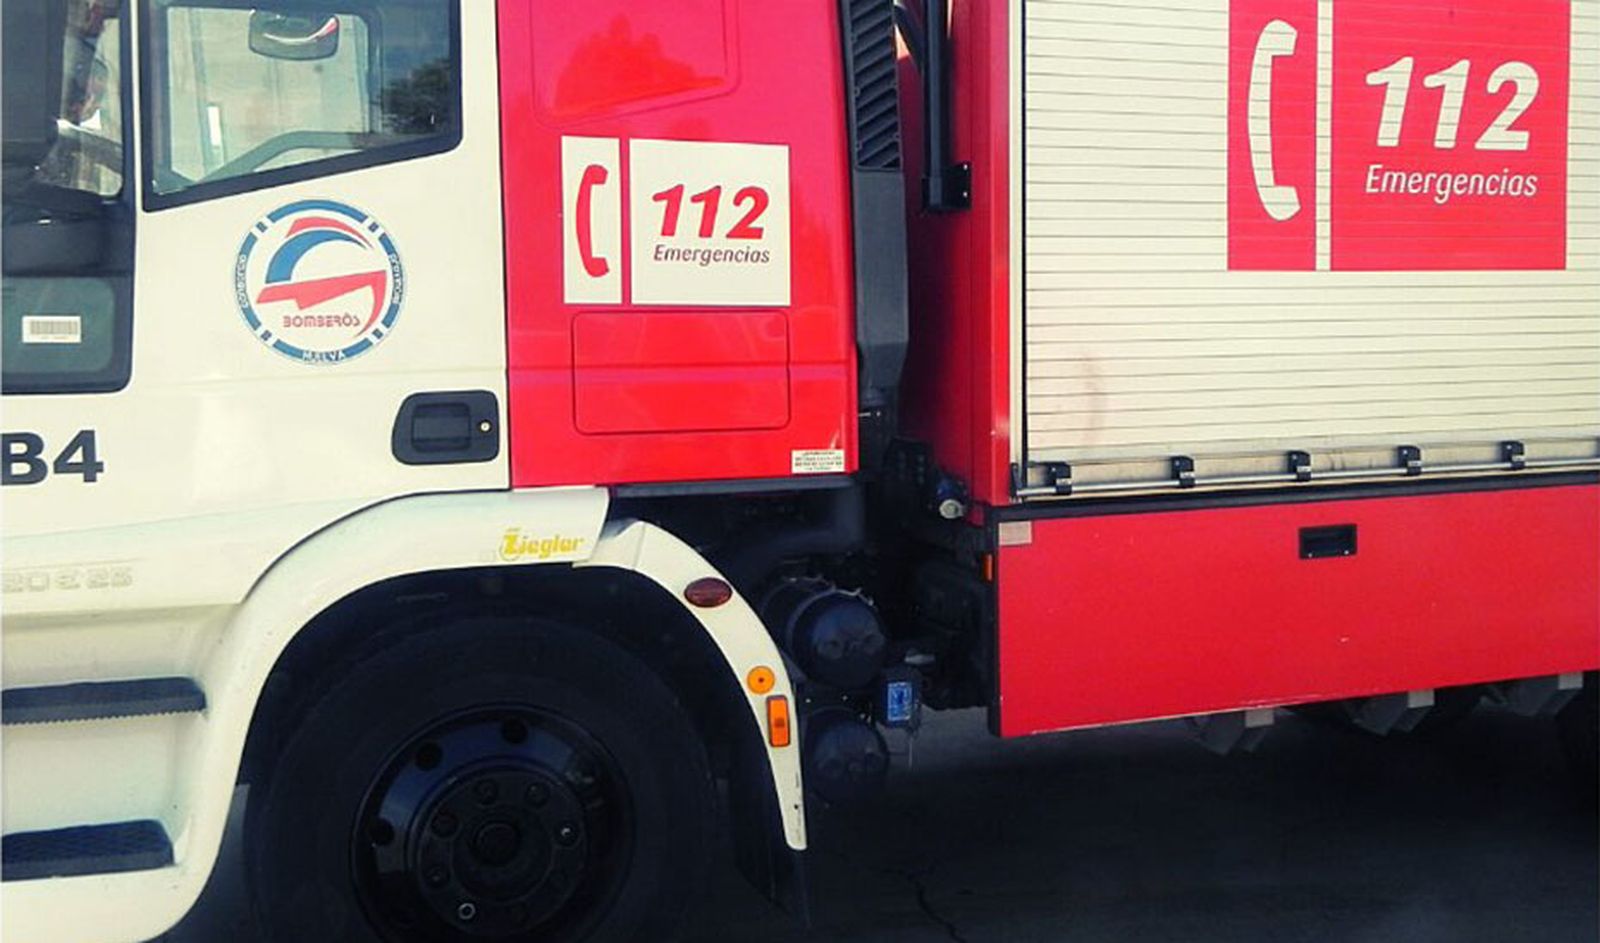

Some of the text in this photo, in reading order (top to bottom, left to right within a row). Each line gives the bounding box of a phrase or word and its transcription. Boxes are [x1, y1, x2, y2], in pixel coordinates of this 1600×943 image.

[1365, 56, 1540, 151] 112
[652, 183, 770, 239] 112
[1365, 164, 1539, 204] Emergencias
[653, 244, 770, 267] Emergencias
[1, 430, 104, 486] B4
